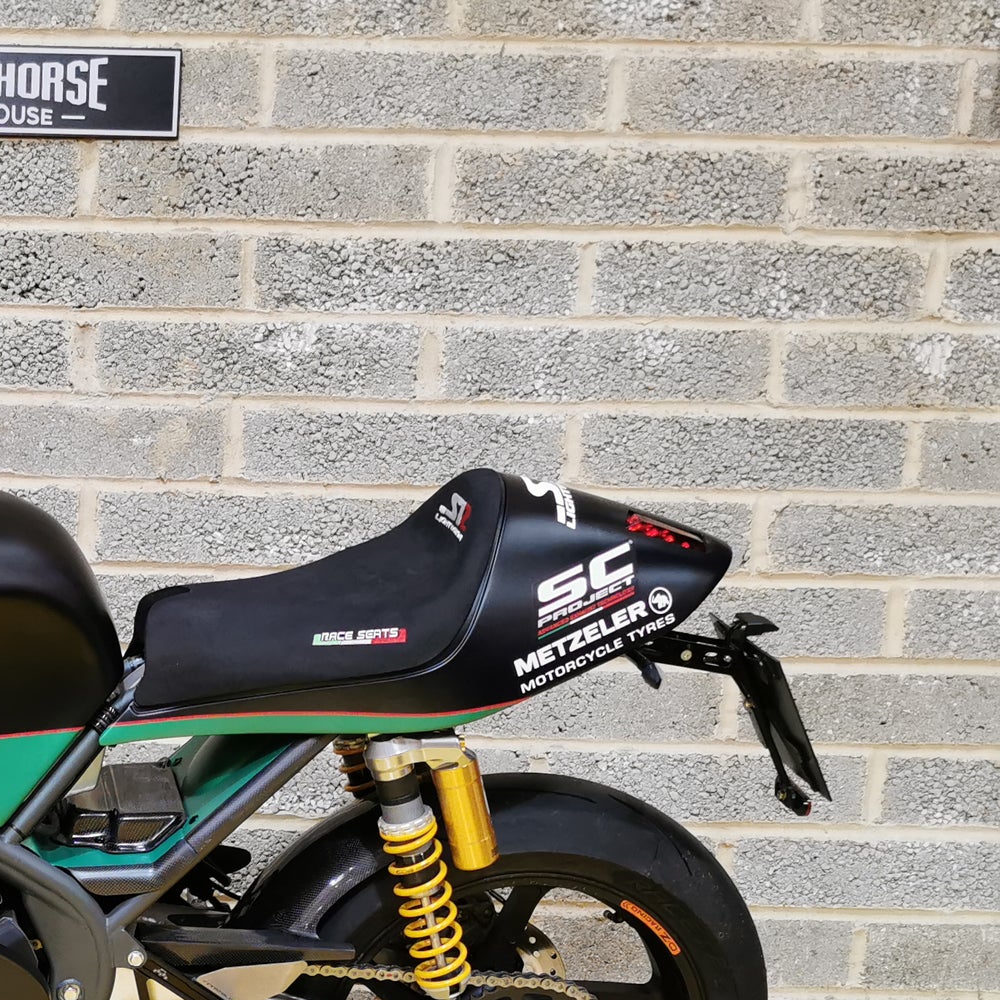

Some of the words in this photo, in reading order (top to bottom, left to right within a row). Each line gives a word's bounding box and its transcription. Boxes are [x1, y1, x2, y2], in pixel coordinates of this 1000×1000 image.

[537, 543, 634, 617] SC
[538, 575, 635, 629] PROJECT
[321, 631, 354, 641] RACE
[356, 628, 399, 640] SEATS
[513, 600, 649, 677] METZELER
[520, 637, 624, 694] MOTORCYCLE
[627, 613, 676, 642] TYRES
